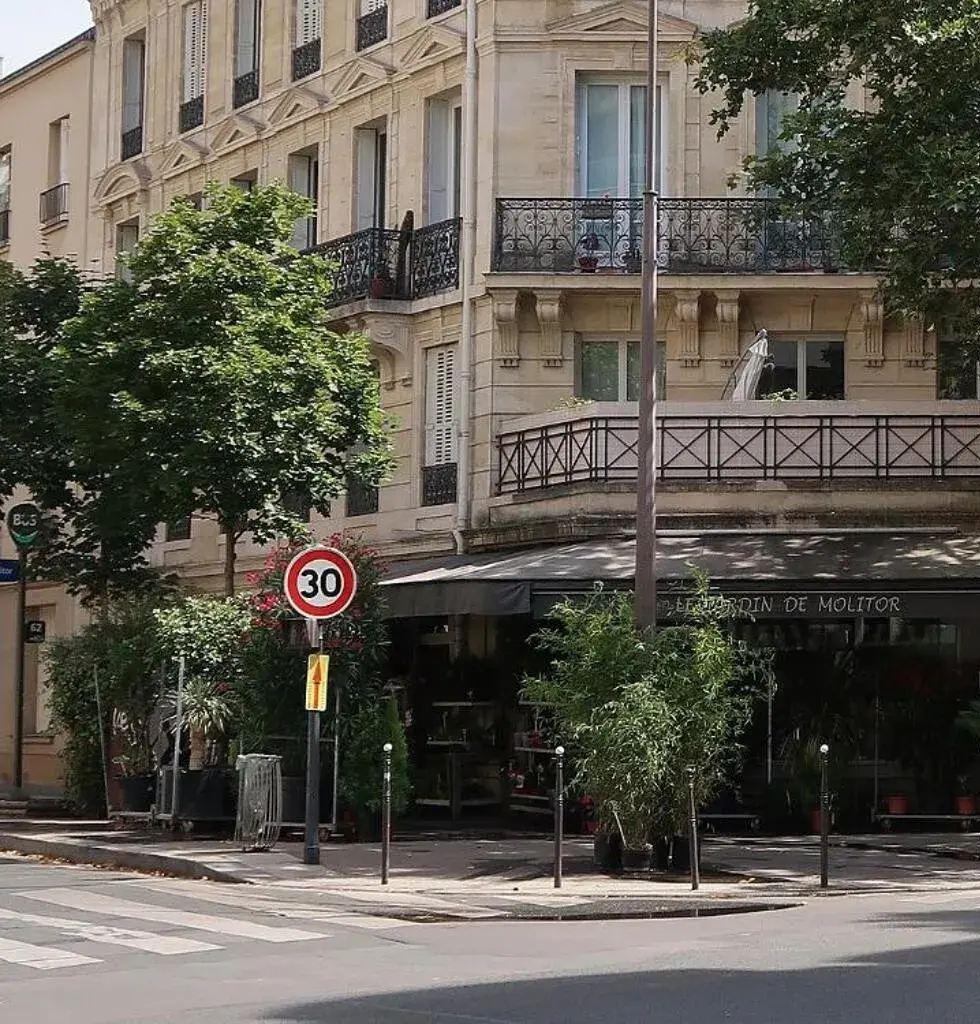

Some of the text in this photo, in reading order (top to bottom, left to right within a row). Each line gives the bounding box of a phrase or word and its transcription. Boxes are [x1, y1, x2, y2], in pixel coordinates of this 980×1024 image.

[13, 514, 37, 526] BUS
[301, 568, 342, 598] 30
[784, 597, 807, 613] DE
[819, 597, 901, 613] MOLITOR
